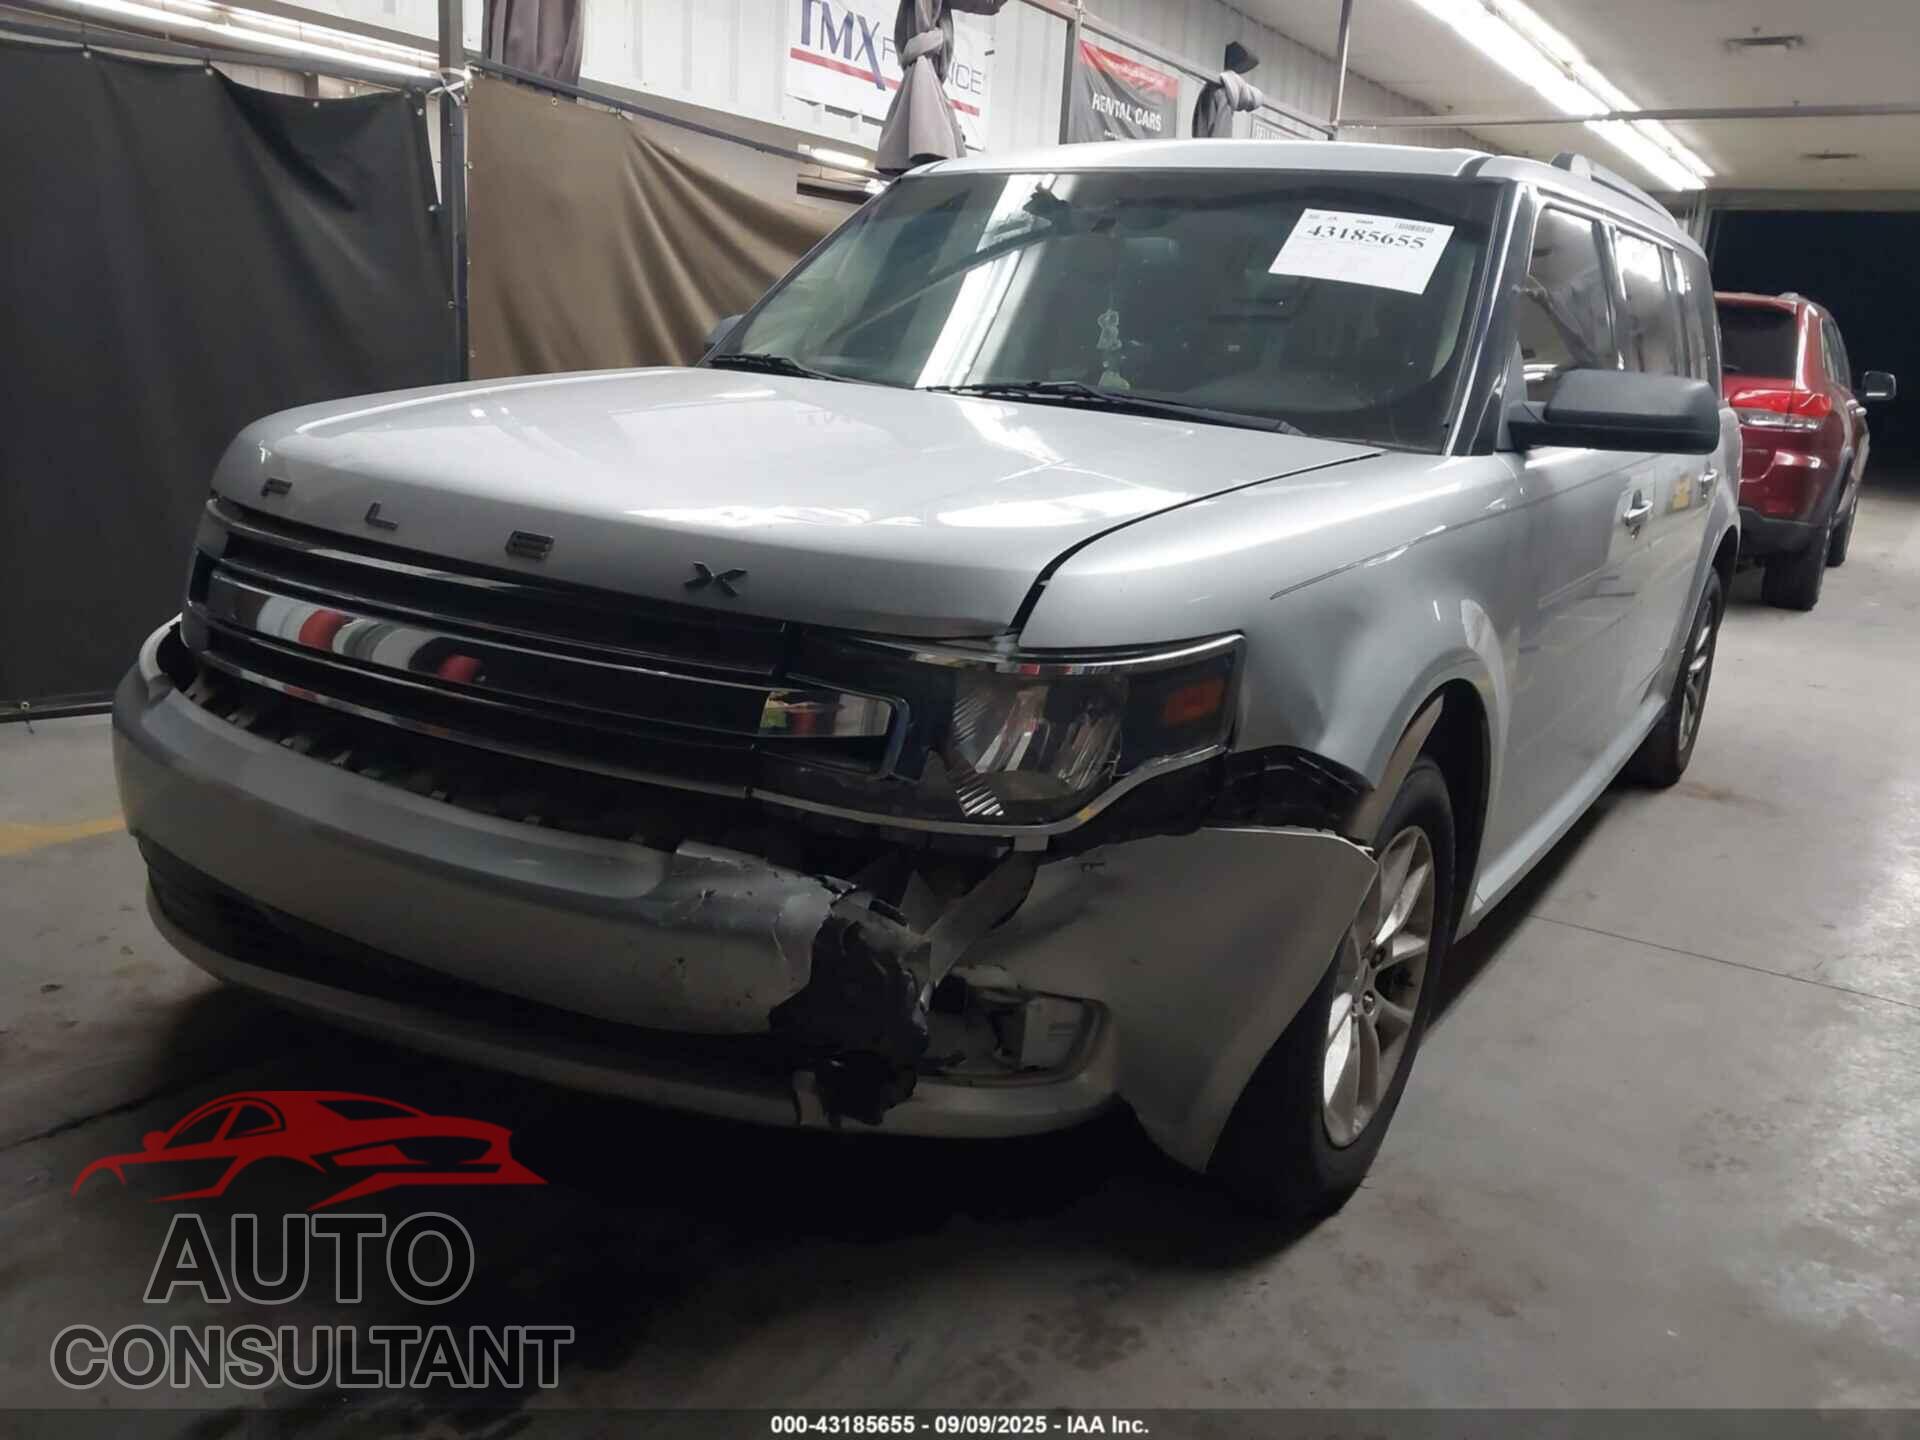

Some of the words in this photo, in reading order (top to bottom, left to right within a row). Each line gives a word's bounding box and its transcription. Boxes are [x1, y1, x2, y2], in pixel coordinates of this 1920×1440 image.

[801, 0, 886, 91] TMX
[1092, 92, 1133, 122] RENTAL
[1134, 107, 1163, 132] CARS
[1307, 224, 1427, 249] 43185655
